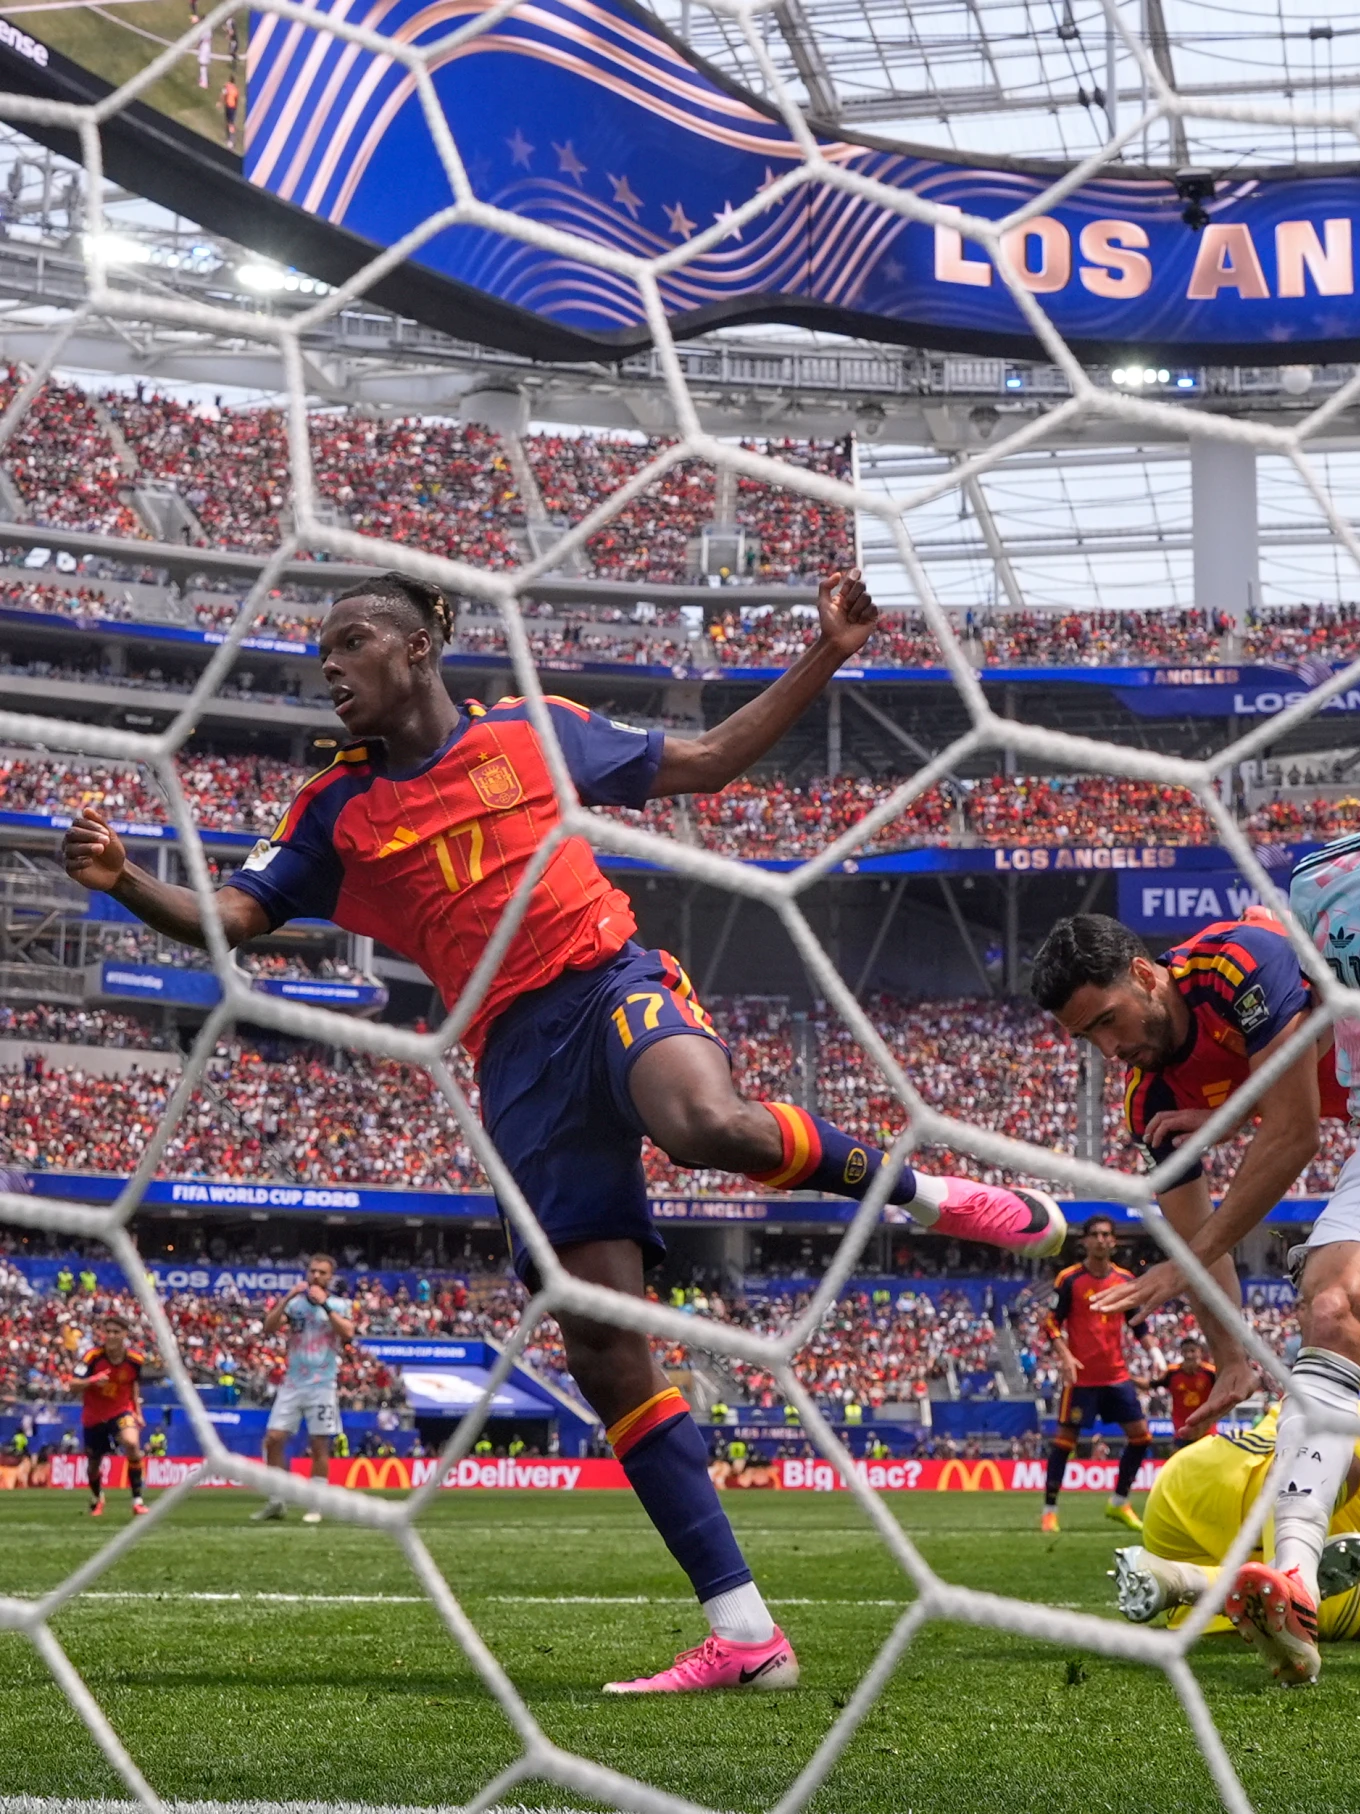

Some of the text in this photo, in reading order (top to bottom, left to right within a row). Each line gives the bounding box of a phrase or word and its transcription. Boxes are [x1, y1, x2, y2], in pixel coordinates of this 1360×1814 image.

[934, 205, 1152, 299] LOS
[429, 819, 484, 893] 17
[995, 848, 1176, 870] LOS ANGELES
[1142, 888, 1223, 917] FIFA
[611, 993, 664, 1050] 17
[173, 1184, 360, 1208] FIFA WORLD CUP 2026
[154, 1270, 304, 1290] LOS ANGE
[76, 1457, 112, 1486] M?
[412, 1457, 581, 1490] McDelivery
[783, 1458, 834, 1491] Big
